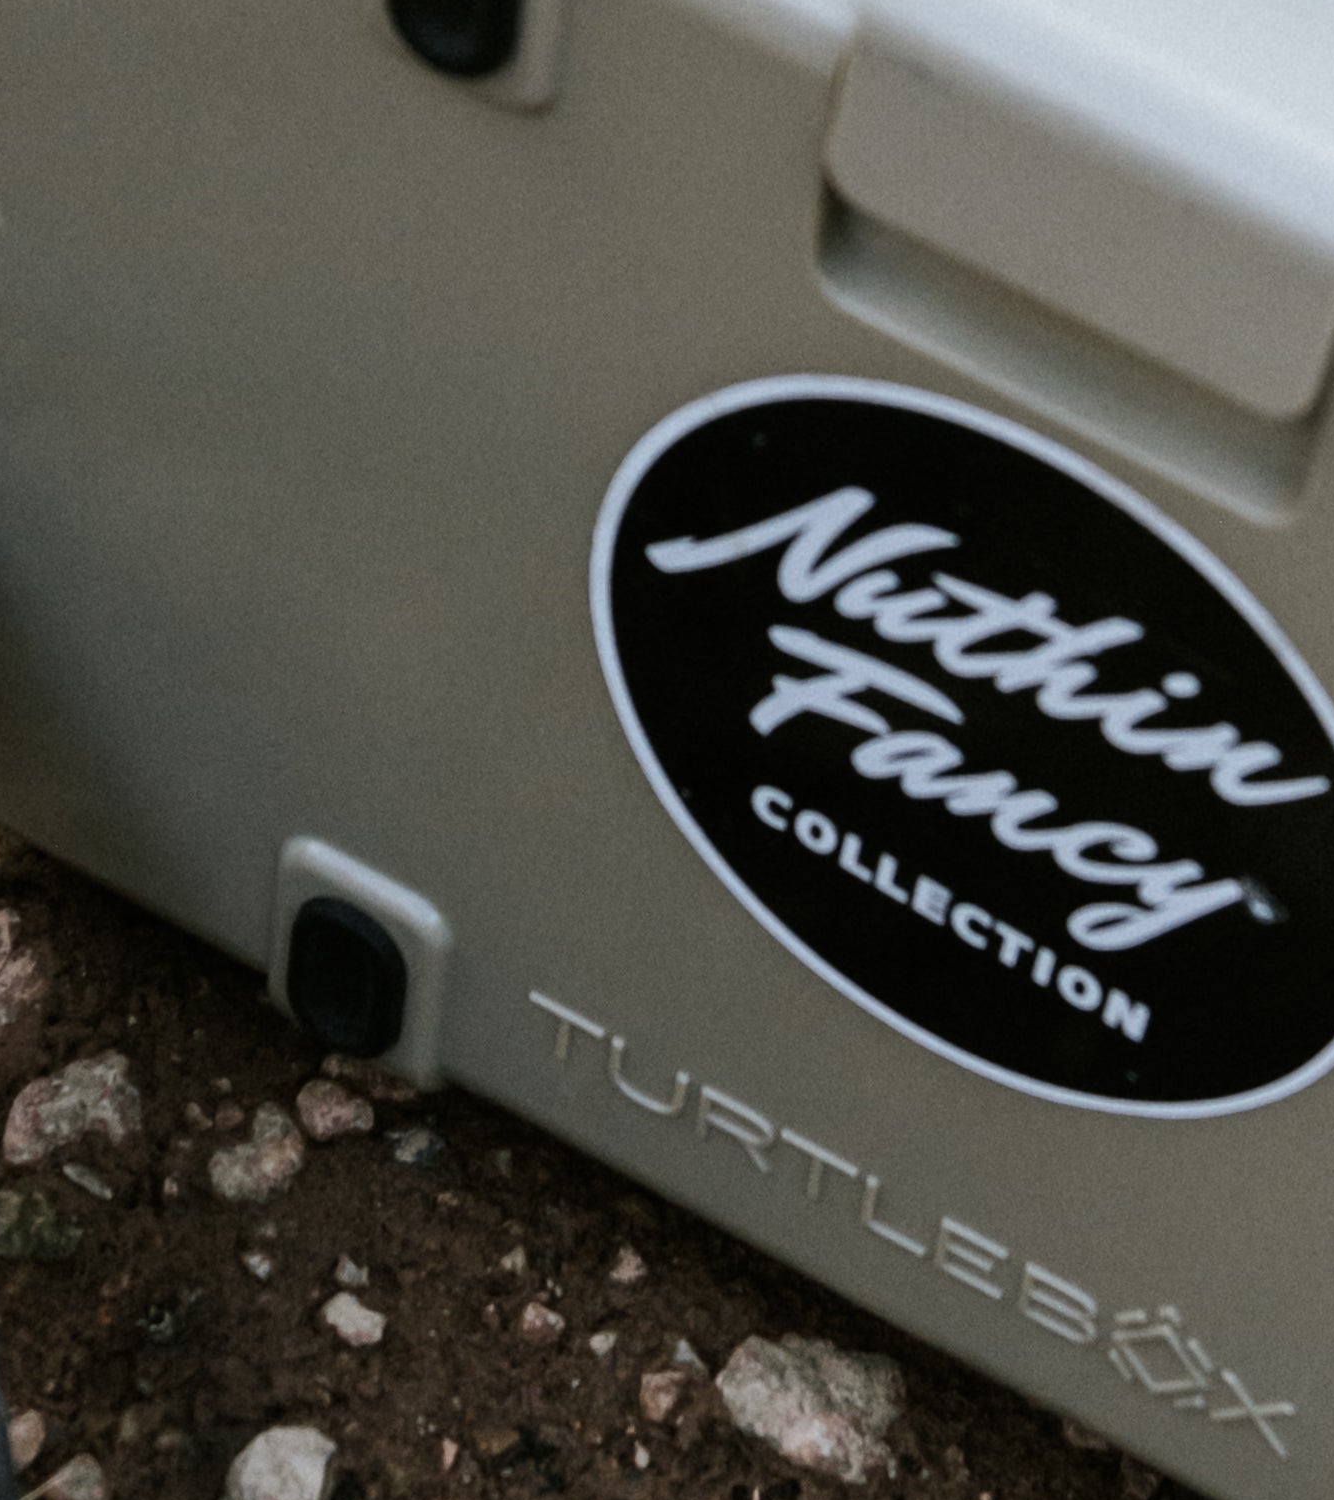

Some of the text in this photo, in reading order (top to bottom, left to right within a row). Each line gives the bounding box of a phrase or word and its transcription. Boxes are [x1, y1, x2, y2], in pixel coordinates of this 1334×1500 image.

[644, 485, 1330, 806] Nuthin
[750, 624, 1245, 951] Fancy
[751, 783, 1150, 1043] COLLECTION
[528, 989, 1297, 1460] TURTLEBOX
